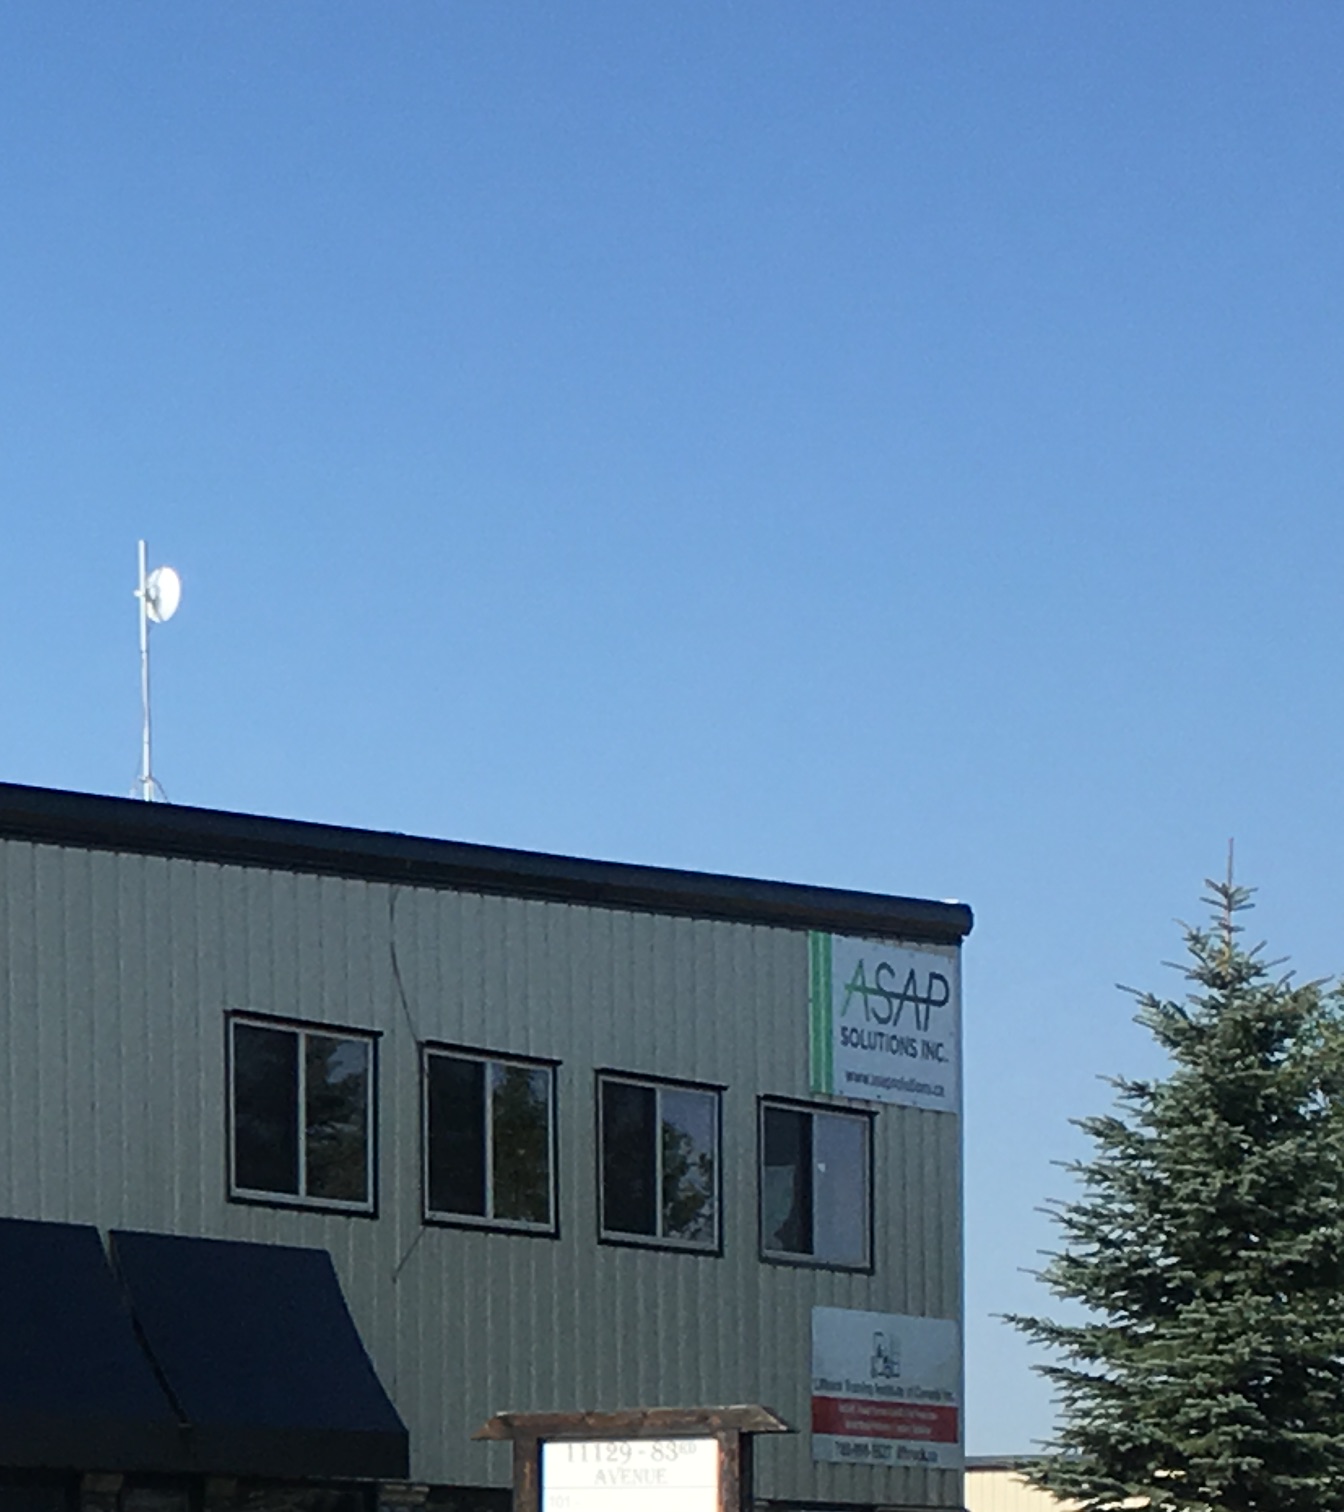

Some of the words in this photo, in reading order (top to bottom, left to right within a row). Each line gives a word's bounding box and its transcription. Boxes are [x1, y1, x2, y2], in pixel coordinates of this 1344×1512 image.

[841, 958, 950, 1032] ASAP
[840, 1026, 918, 1059] SOLUTIONS
[920, 1038, 950, 1063] INC.
[567, 1442, 632, 1464] 11129
[594, 1468, 669, 1485] AVENUE
